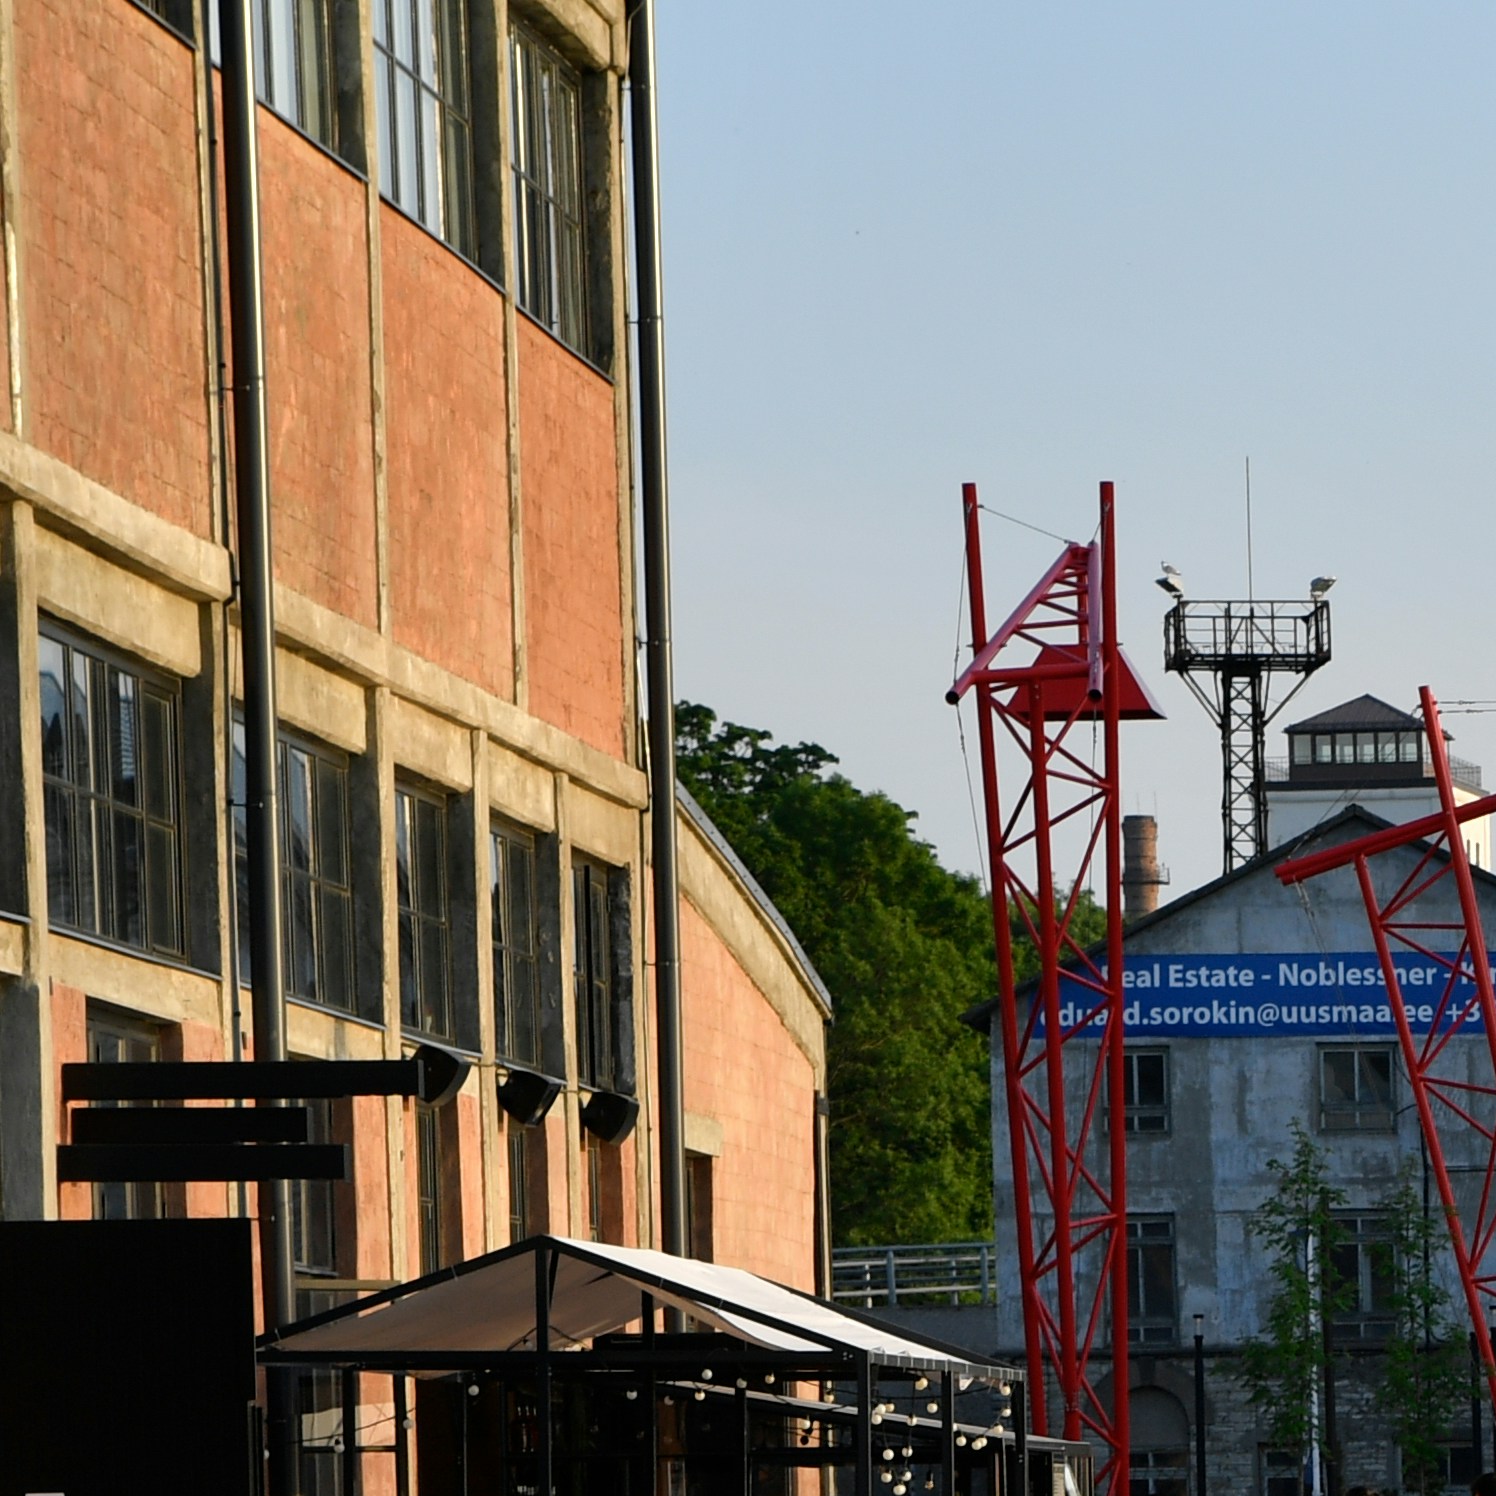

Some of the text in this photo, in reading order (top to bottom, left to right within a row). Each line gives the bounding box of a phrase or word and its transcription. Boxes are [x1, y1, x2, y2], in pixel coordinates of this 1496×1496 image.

[1169, 963, 1254, 988] Estate
[1278, 961, 1437, 987] Noblessner
[1040, 1000, 1433, 1027] duad.sorokin@uusmaaee
